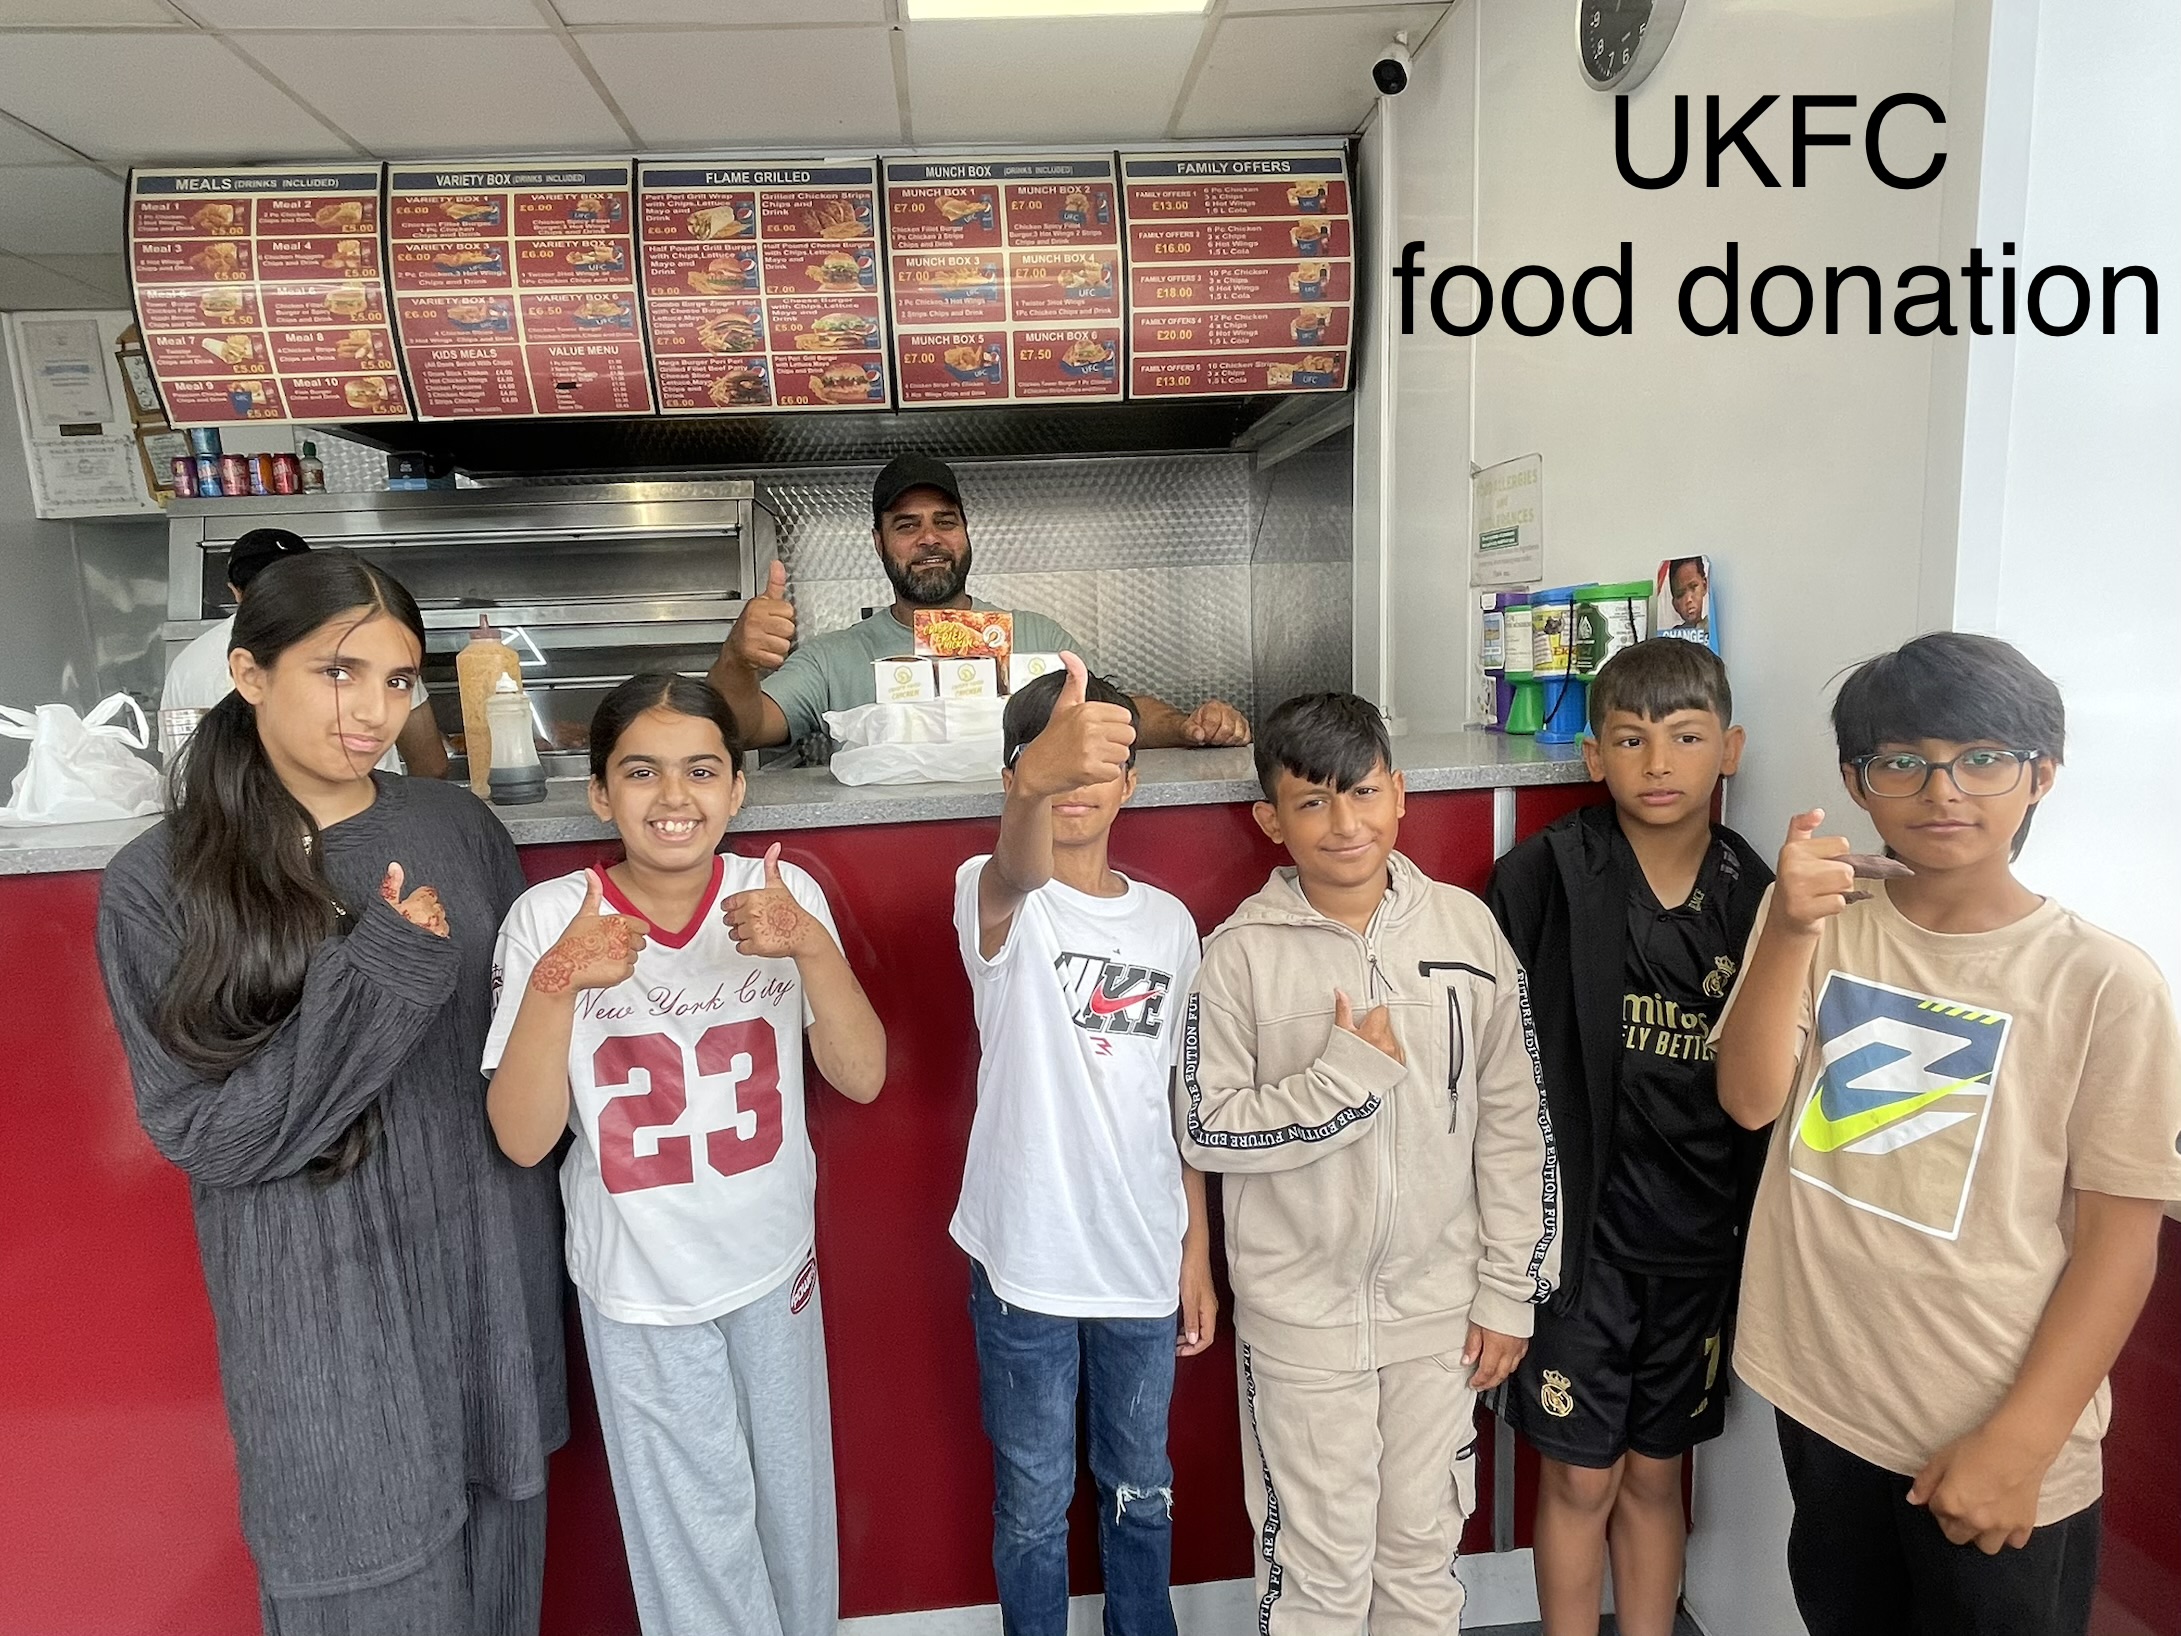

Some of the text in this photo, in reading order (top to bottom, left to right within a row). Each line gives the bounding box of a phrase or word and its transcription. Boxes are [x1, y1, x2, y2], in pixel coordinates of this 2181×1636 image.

[1597, 38, 1604, 55] 8
[926, 166, 992, 177] MUNCH BOX
[1177, 162, 1290, 174] FAMILY OFFERS
[436, 175, 484, 186] VARIETY
[487, 174, 511, 185] BOX
[706, 172, 810, 183] FLAME GRILLED
[176, 179, 339, 190] MEALS (DRINKS INCLUDED)
[902, 189, 941, 197] MUNCH
[1152, 201, 1188, 210] £13.00
[142, 245, 172, 253] Meal
[273, 242, 300, 250] Meal
[1155, 243, 1191, 253] £16.00
[906, 257, 980, 266] MUNCH BOX 3
[1022, 255, 1061, 264] MUNCH
[1088, 254, 1095, 262] 4
[1156, 288, 1192, 298] £18.00
[285, 333, 314, 342] Meal
[912, 335, 984, 345] MUNCH BOX 5
[1026, 331, 1098, 341] MUNCH BOX 6
[1157, 330, 1192, 340] £20.00
[156, 336, 185, 346] Meal
[432, 349, 497, 360] KIDS MEALS
[549, 346, 619, 356] VALUE MENU
[1020, 349, 1052, 360] £7.50
[293, 378, 321, 388] Meal
[1156, 376, 1191, 386] £13.00
[175, 382, 203, 391] Meal
[574, 967, 796, 1022] New York City
[1655, 1031, 1717, 1062] BETT
[1185, 1025, 1199, 1082] EDITION
[593, 1016, 784, 1195] 23
[1525, 1028, 1541, 1084] EDITION
[1544, 1146, 1557, 1202] EDITION
